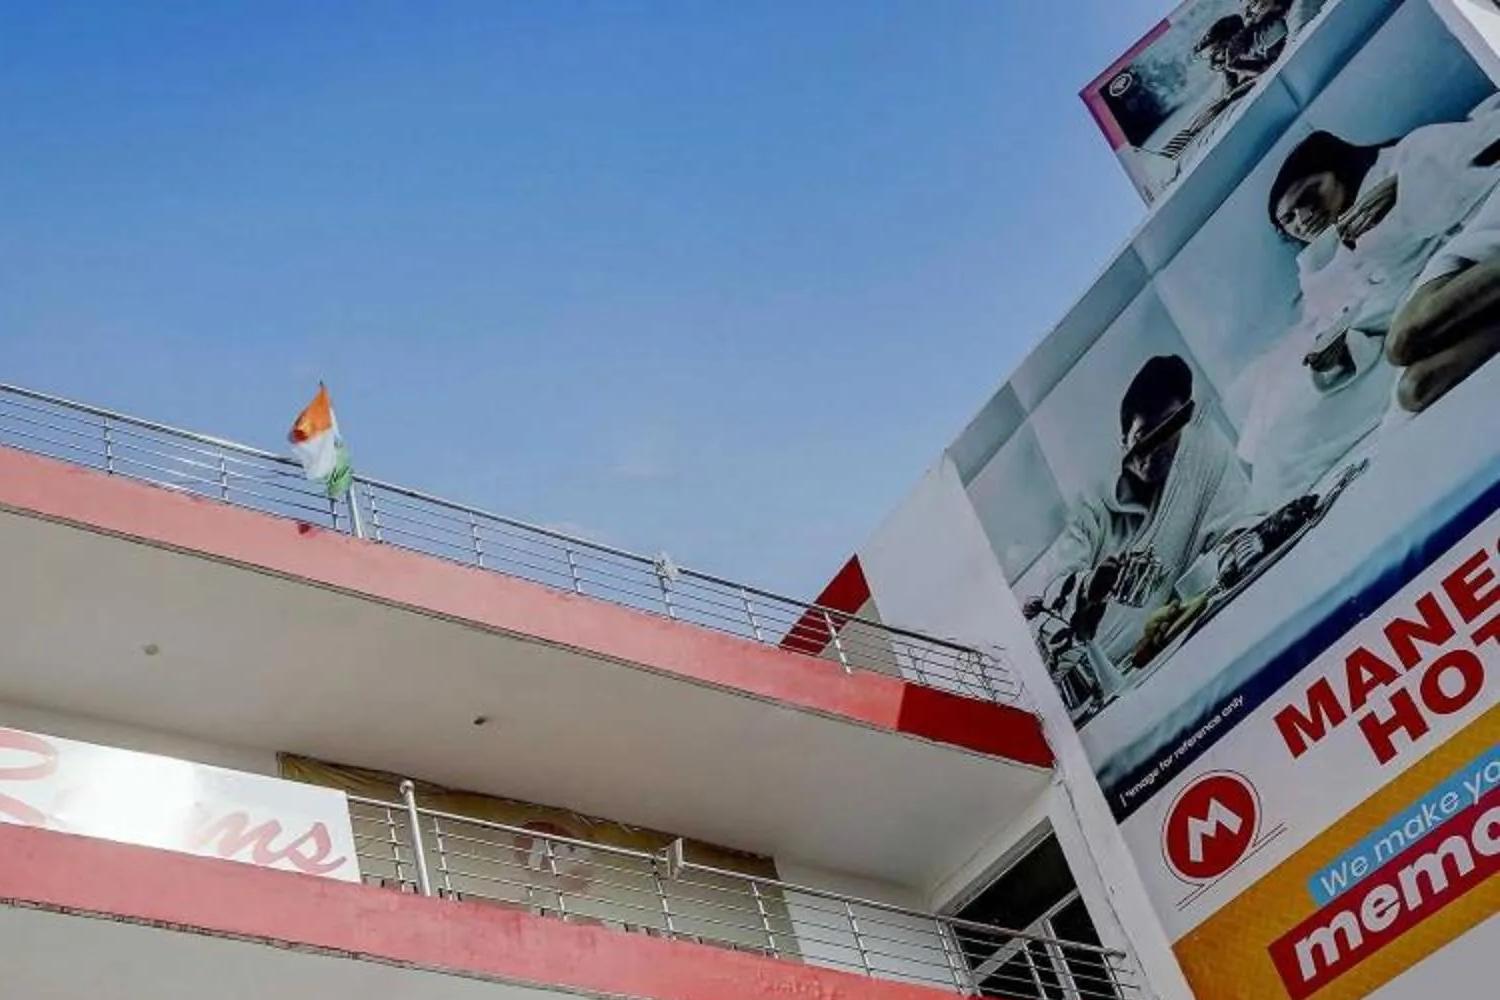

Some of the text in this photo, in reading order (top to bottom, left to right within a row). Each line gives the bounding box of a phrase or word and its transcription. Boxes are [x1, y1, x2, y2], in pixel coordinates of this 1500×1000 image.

[1273, 537, 1500, 759] MANE
[1320, 853, 1369, 899] We
[1374, 789, 1460, 860] make
